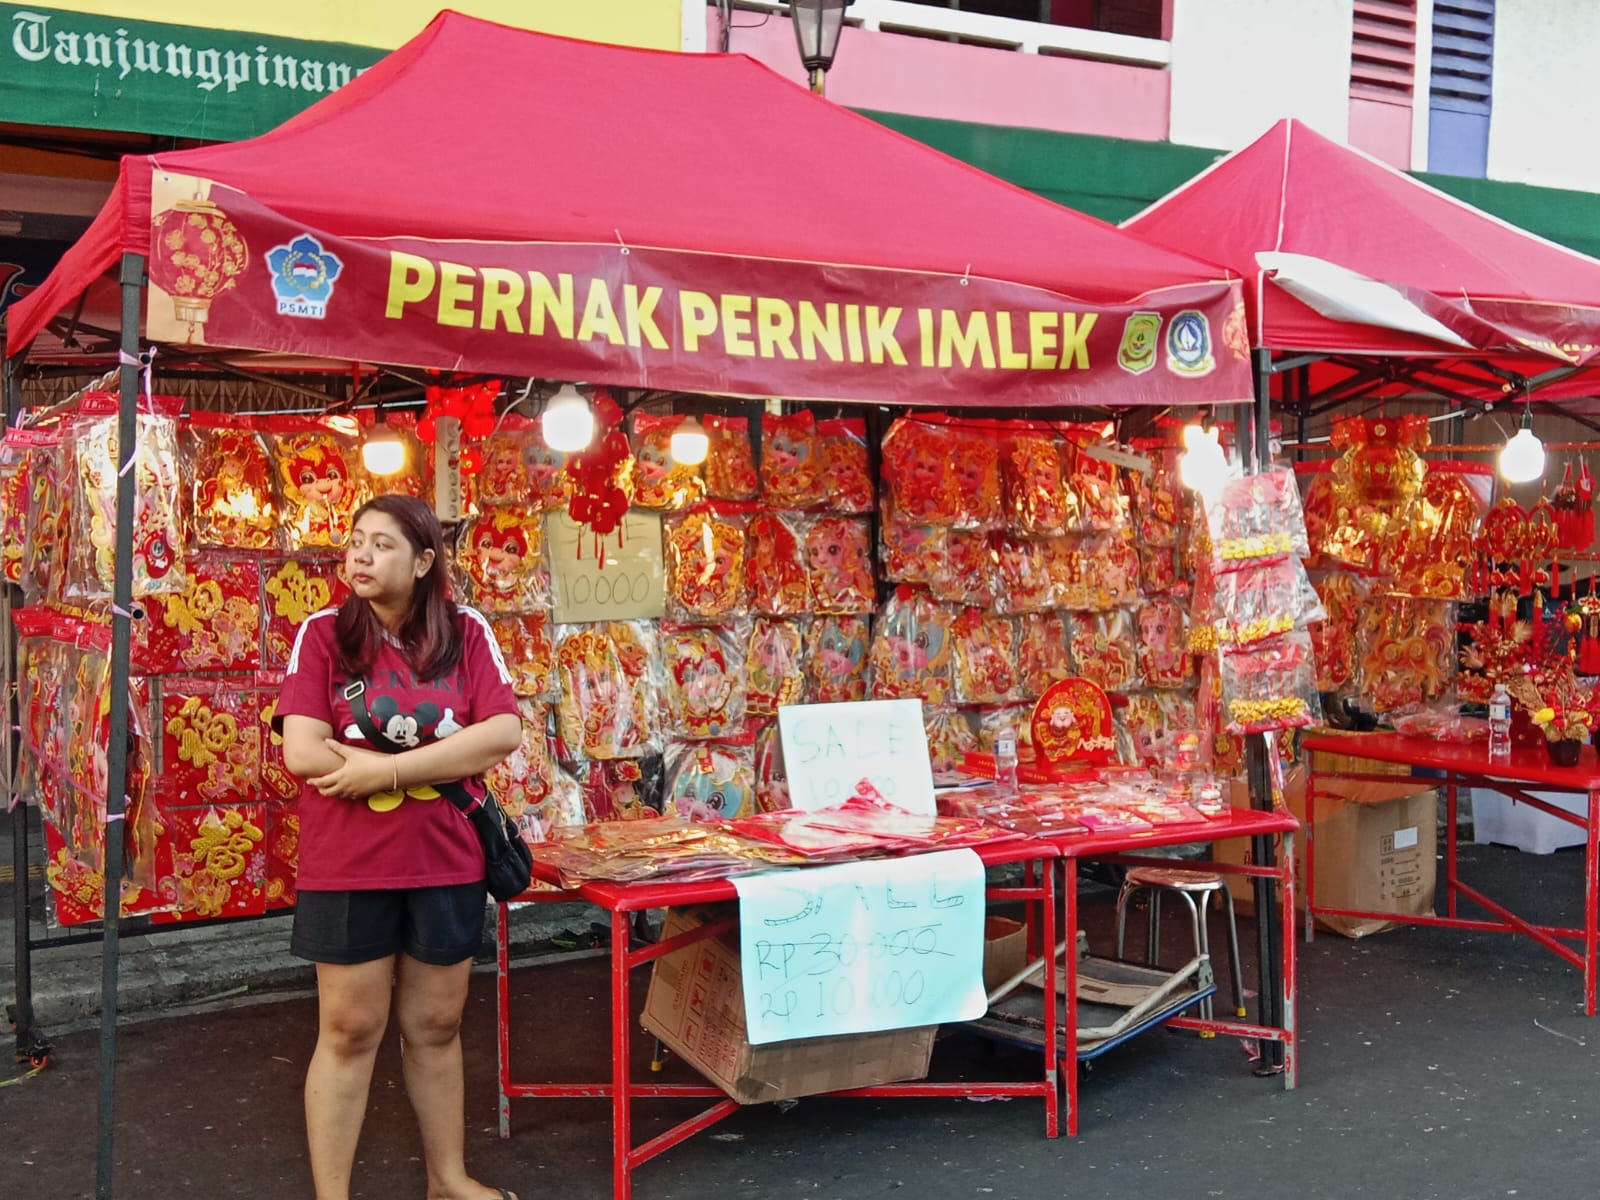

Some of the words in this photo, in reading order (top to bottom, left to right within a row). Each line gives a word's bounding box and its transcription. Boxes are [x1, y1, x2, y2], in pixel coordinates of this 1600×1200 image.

[12, 11, 370, 93] Tanjungpinan
[279, 302, 324, 317] PSMTI
[385, 250, 670, 350] PERNAK
[679, 291, 908, 366] PERNIK
[919, 307, 1098, 370] IMLEK
[559, 509, 649, 544] SE
[793, 718, 904, 764] SALE
